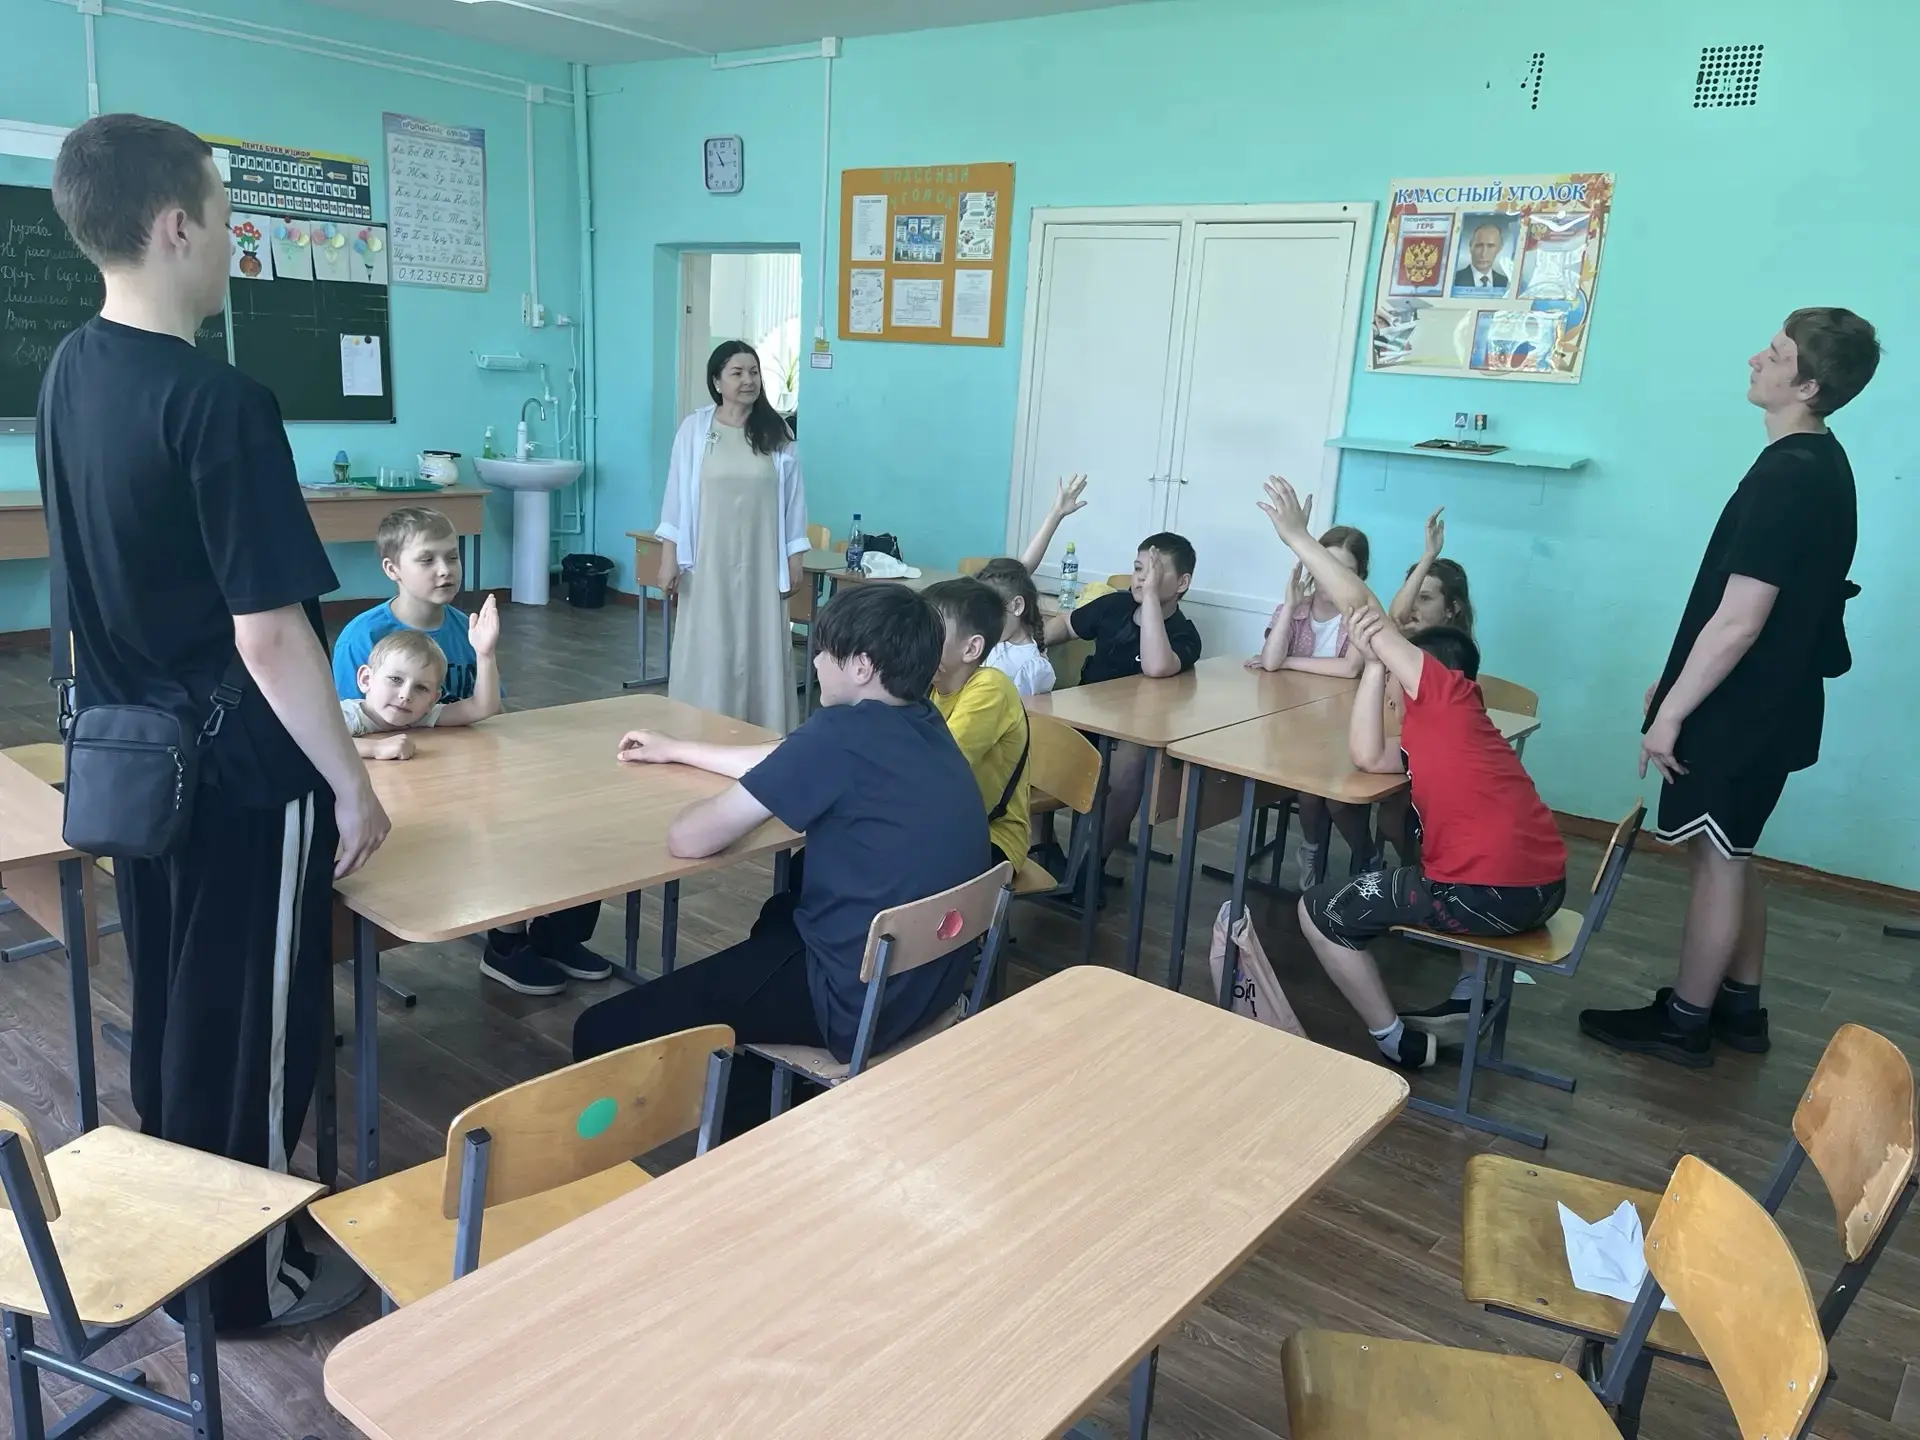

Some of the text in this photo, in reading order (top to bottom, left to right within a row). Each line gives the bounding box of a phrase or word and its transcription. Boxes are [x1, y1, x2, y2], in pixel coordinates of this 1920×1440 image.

[241, 142, 263, 151] ЛЕНТА
[265, 146, 283, 155] БУКВ
[291, 150, 311, 158] ЦИФР
[1398, 181, 1586, 204] КЛАССНЫЙ УГОЛОК
[8, 218, 52, 245] ружба
